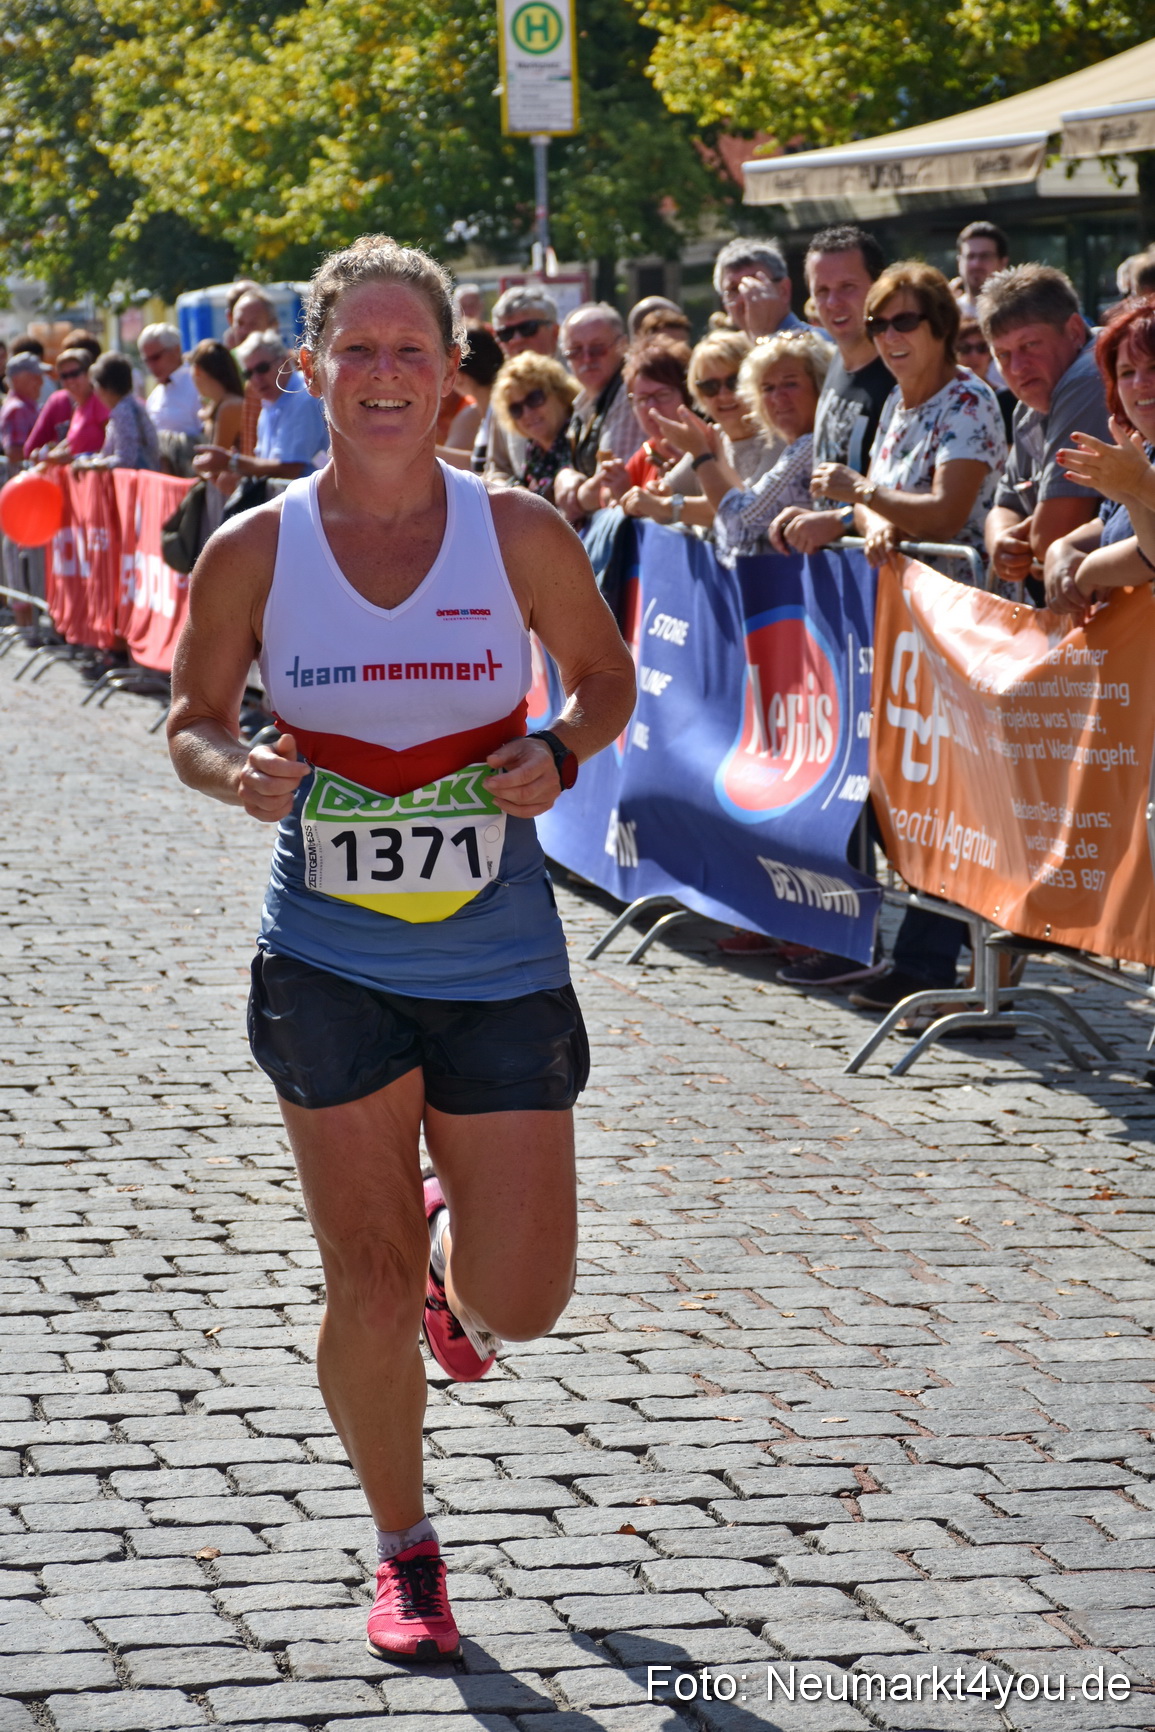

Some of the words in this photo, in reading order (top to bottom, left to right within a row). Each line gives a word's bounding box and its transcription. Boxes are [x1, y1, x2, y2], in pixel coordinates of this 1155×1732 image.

[649, 613, 689, 646] STORE
[1065, 643, 1108, 666] Partner
[285, 656, 356, 688] team
[362, 649, 503, 681] memmert
[1038, 675, 1058, 697] und
[1042, 711, 1068, 729] was
[1025, 738, 1046, 759] und
[1075, 812, 1111, 829] uns:
[331, 826, 482, 882] 1371
